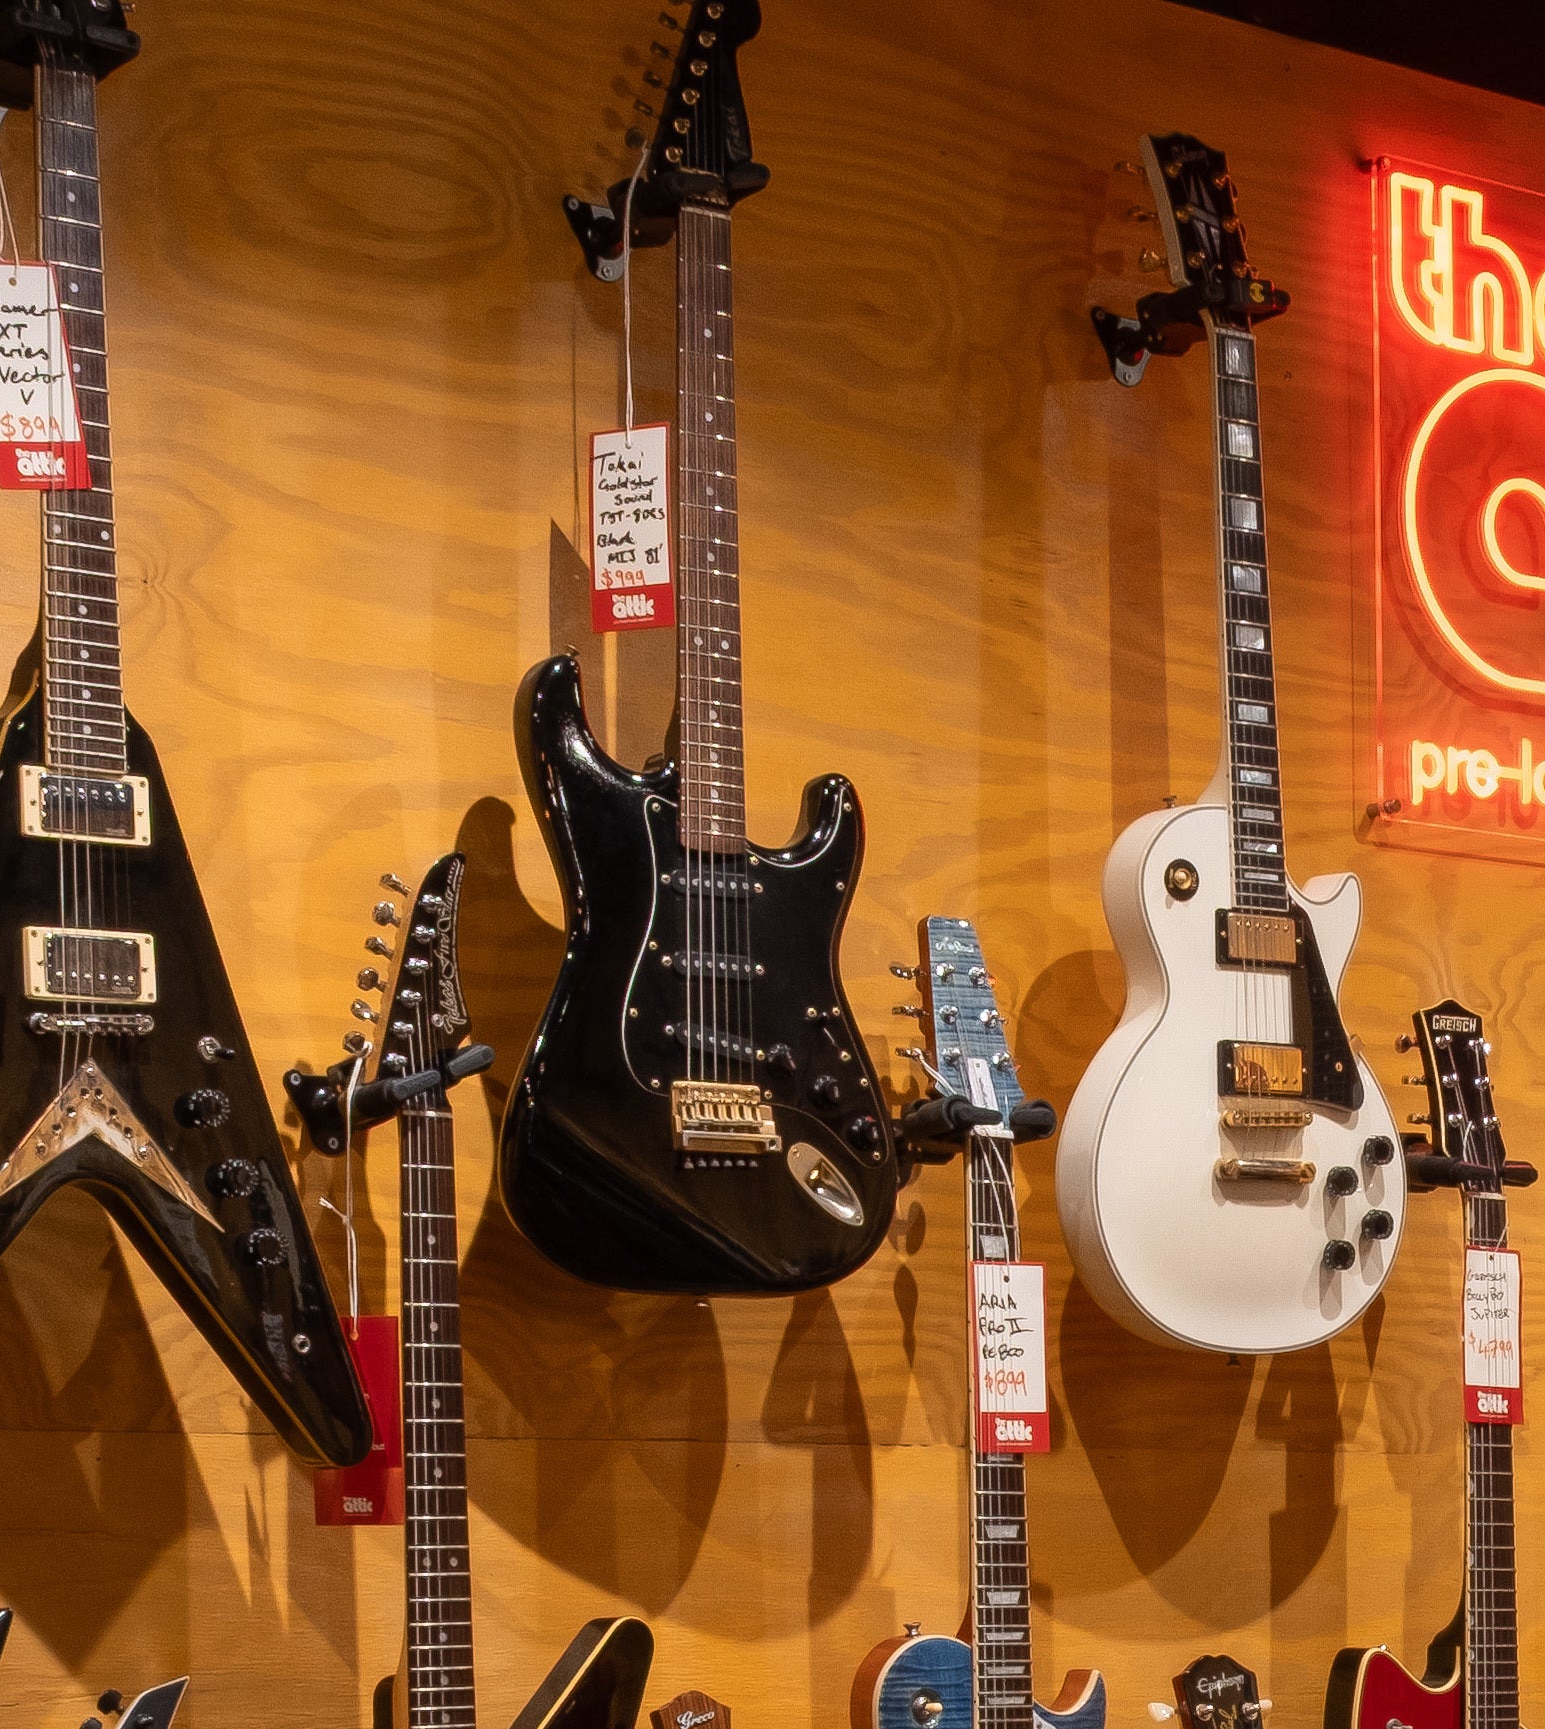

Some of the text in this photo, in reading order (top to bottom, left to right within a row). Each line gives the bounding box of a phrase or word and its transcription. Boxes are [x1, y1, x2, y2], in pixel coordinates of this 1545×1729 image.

[19, 387, 36, 405] V
[16, 449, 67, 477] attic
[607, 548, 637, 564] MIJ
[601, 568, 647, 588] $999
[612, 593, 655, 619] attic
[1431, 1014, 1477, 1033] GRETSCH
[983, 1370, 1029, 1398] $899
[1477, 1391, 1509, 1415] attic
[995, 1417, 1034, 1441] attic
[1196, 1673, 1246, 1700] Epiphone
